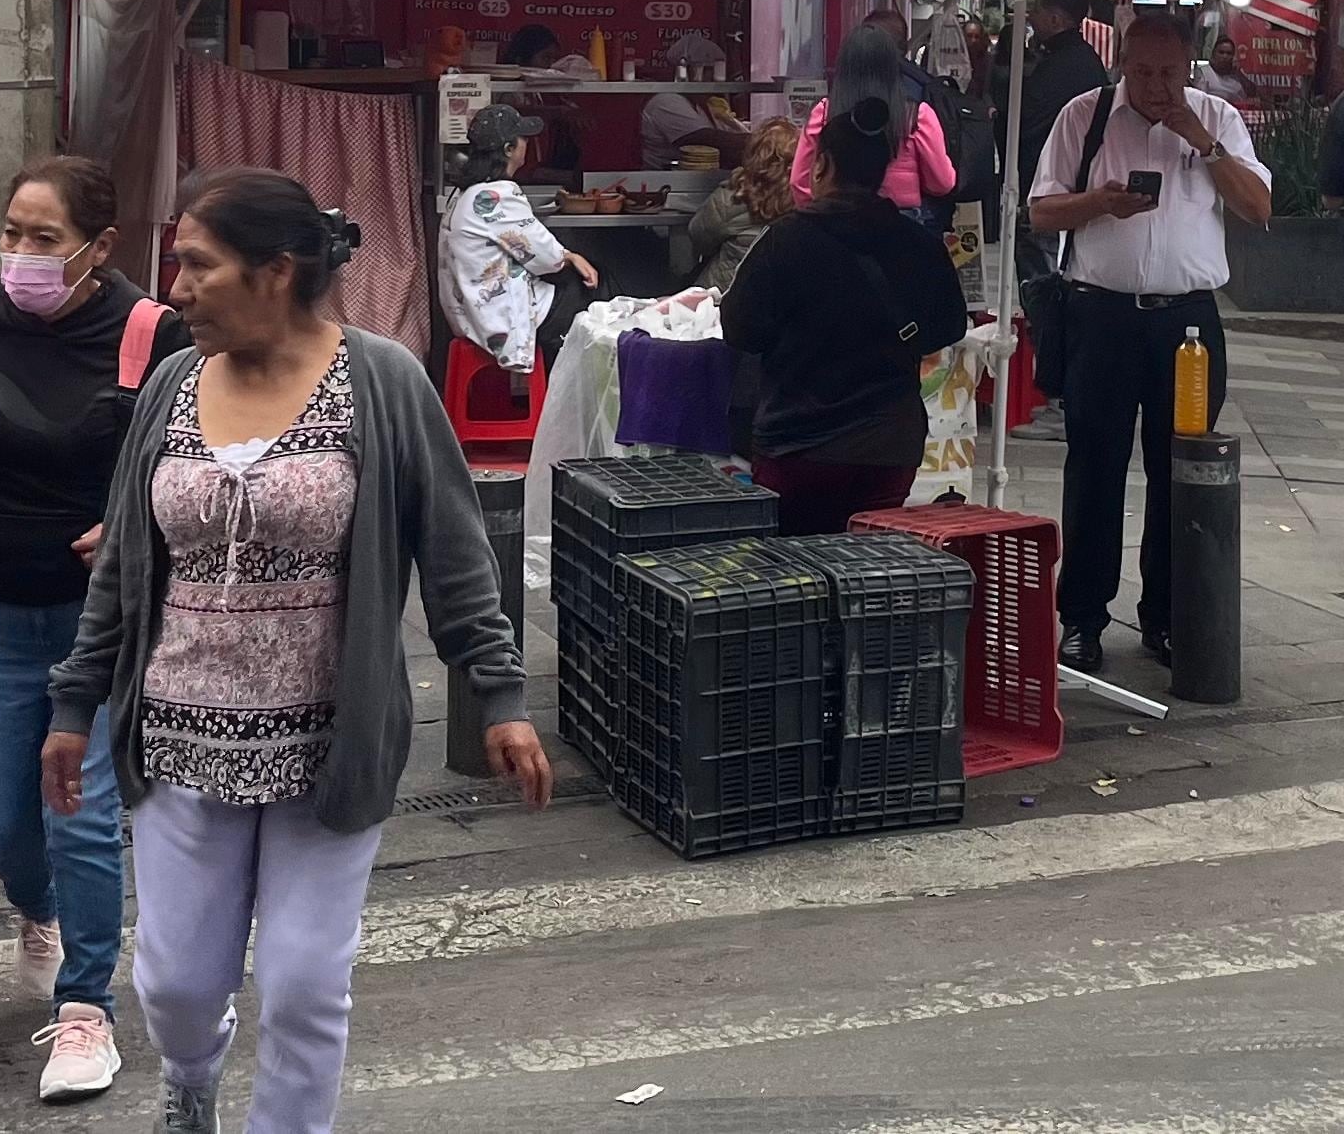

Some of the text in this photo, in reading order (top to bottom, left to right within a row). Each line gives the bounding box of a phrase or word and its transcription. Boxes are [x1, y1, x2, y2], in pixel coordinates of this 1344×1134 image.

[525, 3, 687, 18] Con Queso $30
[1252, 38, 1303, 51] FRUTA CON
[1258, 53, 1296, 67] YOGURT
[1248, 73, 1292, 88] HANTILLY
